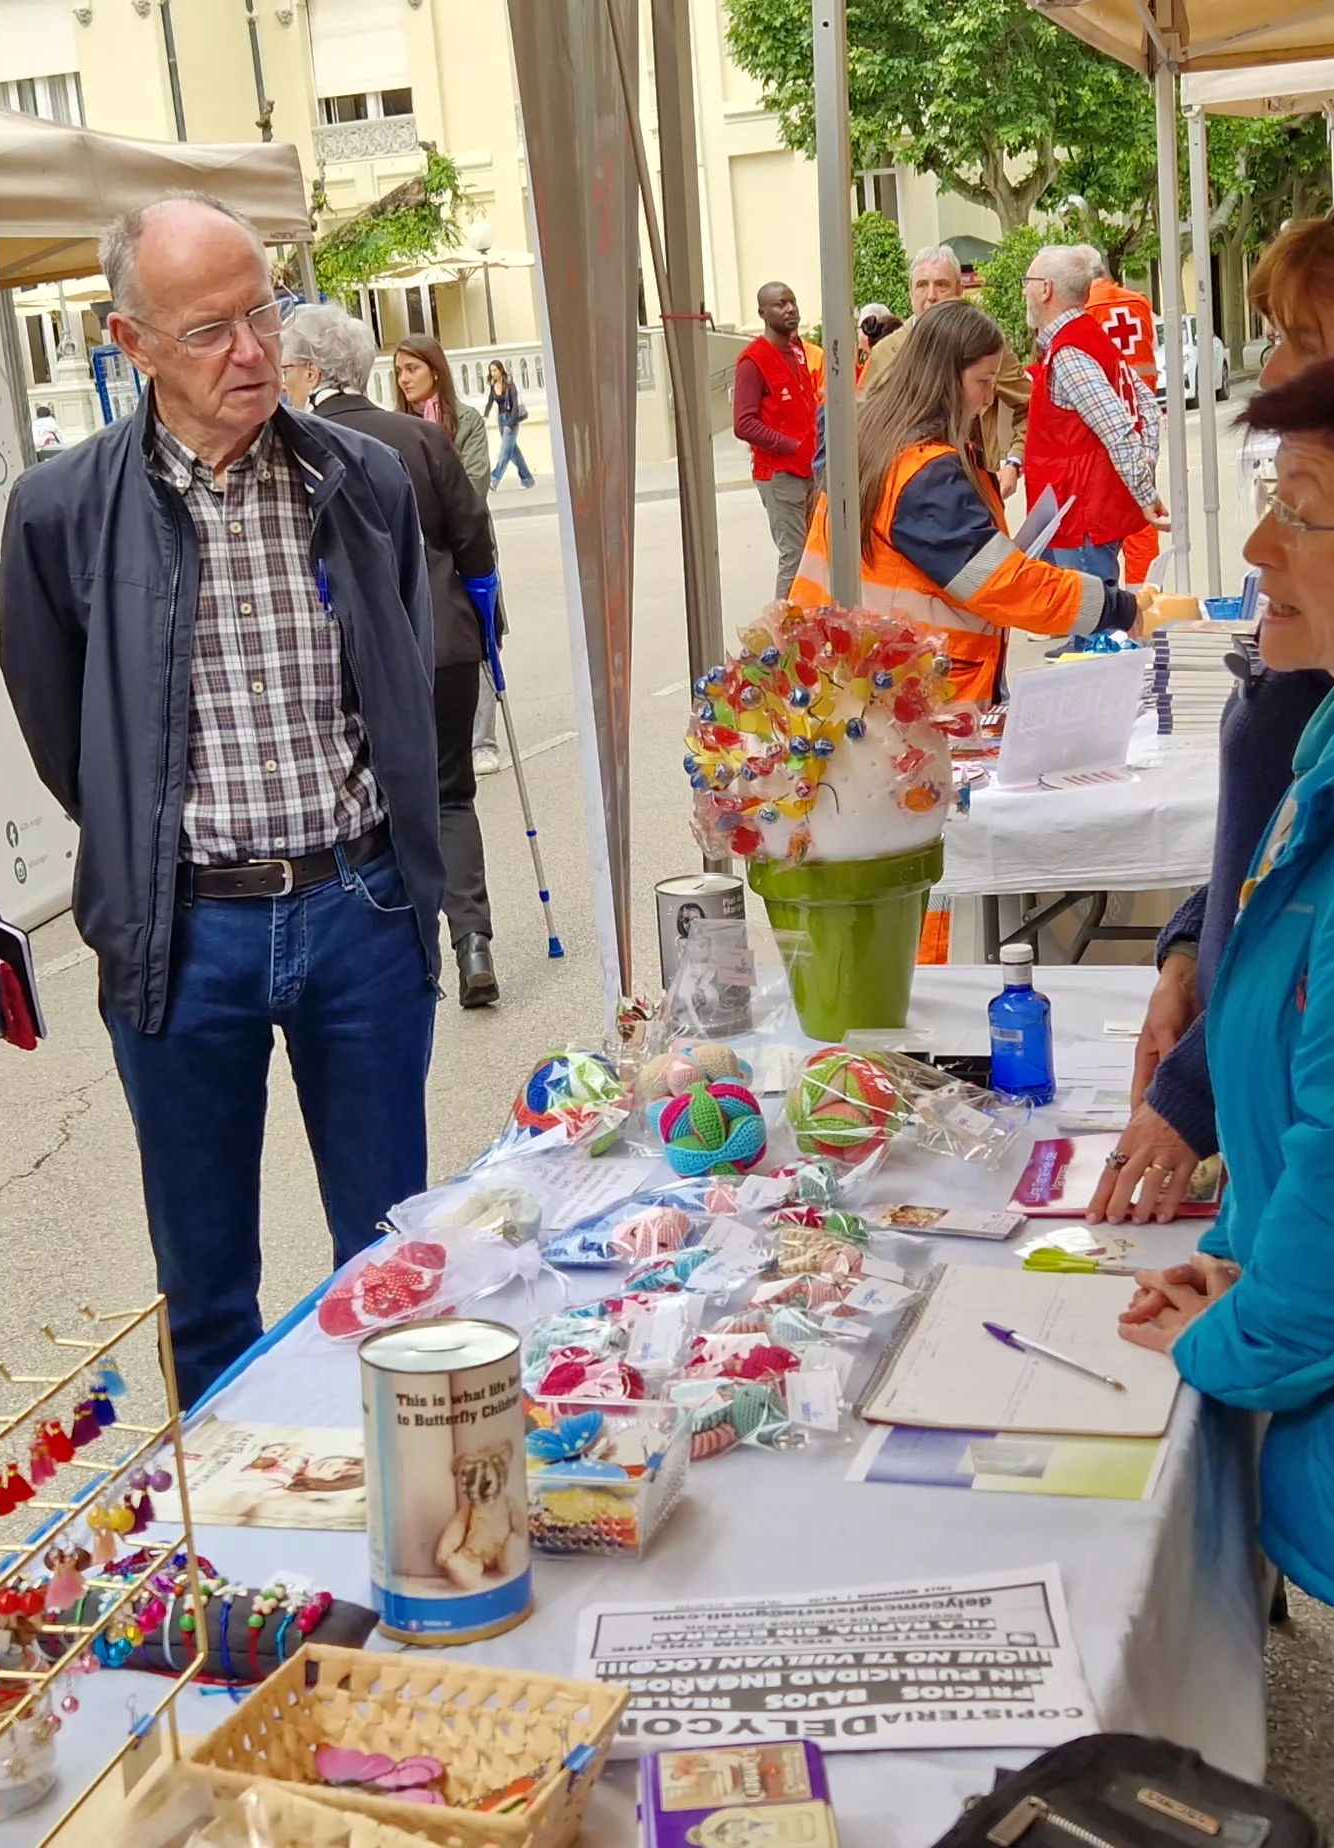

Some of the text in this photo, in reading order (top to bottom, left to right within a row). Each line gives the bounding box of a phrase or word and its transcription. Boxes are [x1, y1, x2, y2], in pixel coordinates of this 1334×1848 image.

[396, 1381, 507, 1407] This is what life
[397, 1414, 410, 1426] to
[415, 1410, 478, 1426] Butterfly
[775, 1626, 821, 1636] SIN
[938, 1619, 996, 1630] FILA
[651, 1630, 769, 1643] ESPERAS
[843, 1631, 992, 1644] COPISTERIA
[717, 1653, 855, 1670] VUELVAN
[862, 1652, 898, 1665] TE
[904, 1651, 951, 1664] NO
[789, 1668, 982, 1686] PUBLICIDAD
[989, 1668, 1046, 1683] SIN
[764, 1688, 869, 1710] BAJOS
[901, 1685, 1034, 1700] PRECIOS
[880, 1706, 1084, 1725] COPISTERIA
